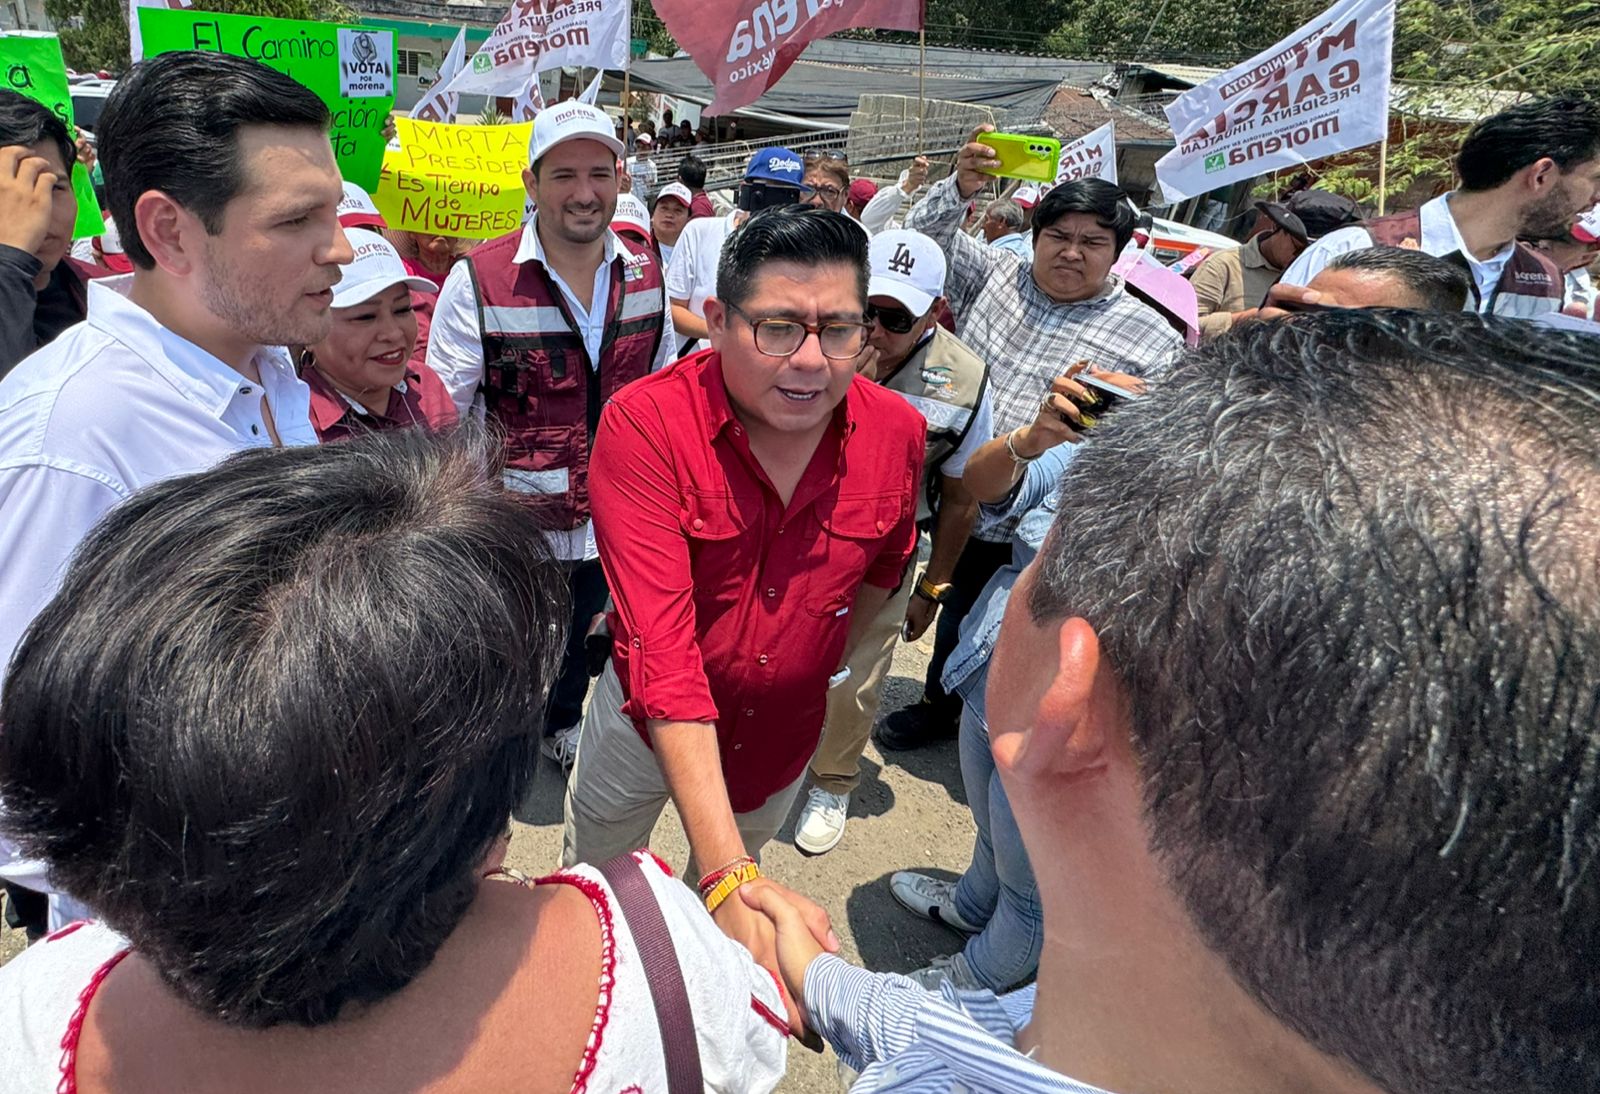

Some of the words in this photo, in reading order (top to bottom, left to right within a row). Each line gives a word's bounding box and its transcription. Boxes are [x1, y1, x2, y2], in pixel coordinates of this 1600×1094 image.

[242, 25, 336, 60] Camino
[349, 62, 384, 74] VOTA
[328, 99, 378, 129] ción
[555, 109, 596, 123] morena
[435, 195, 461, 211] de
[888, 243, 915, 276] LA
